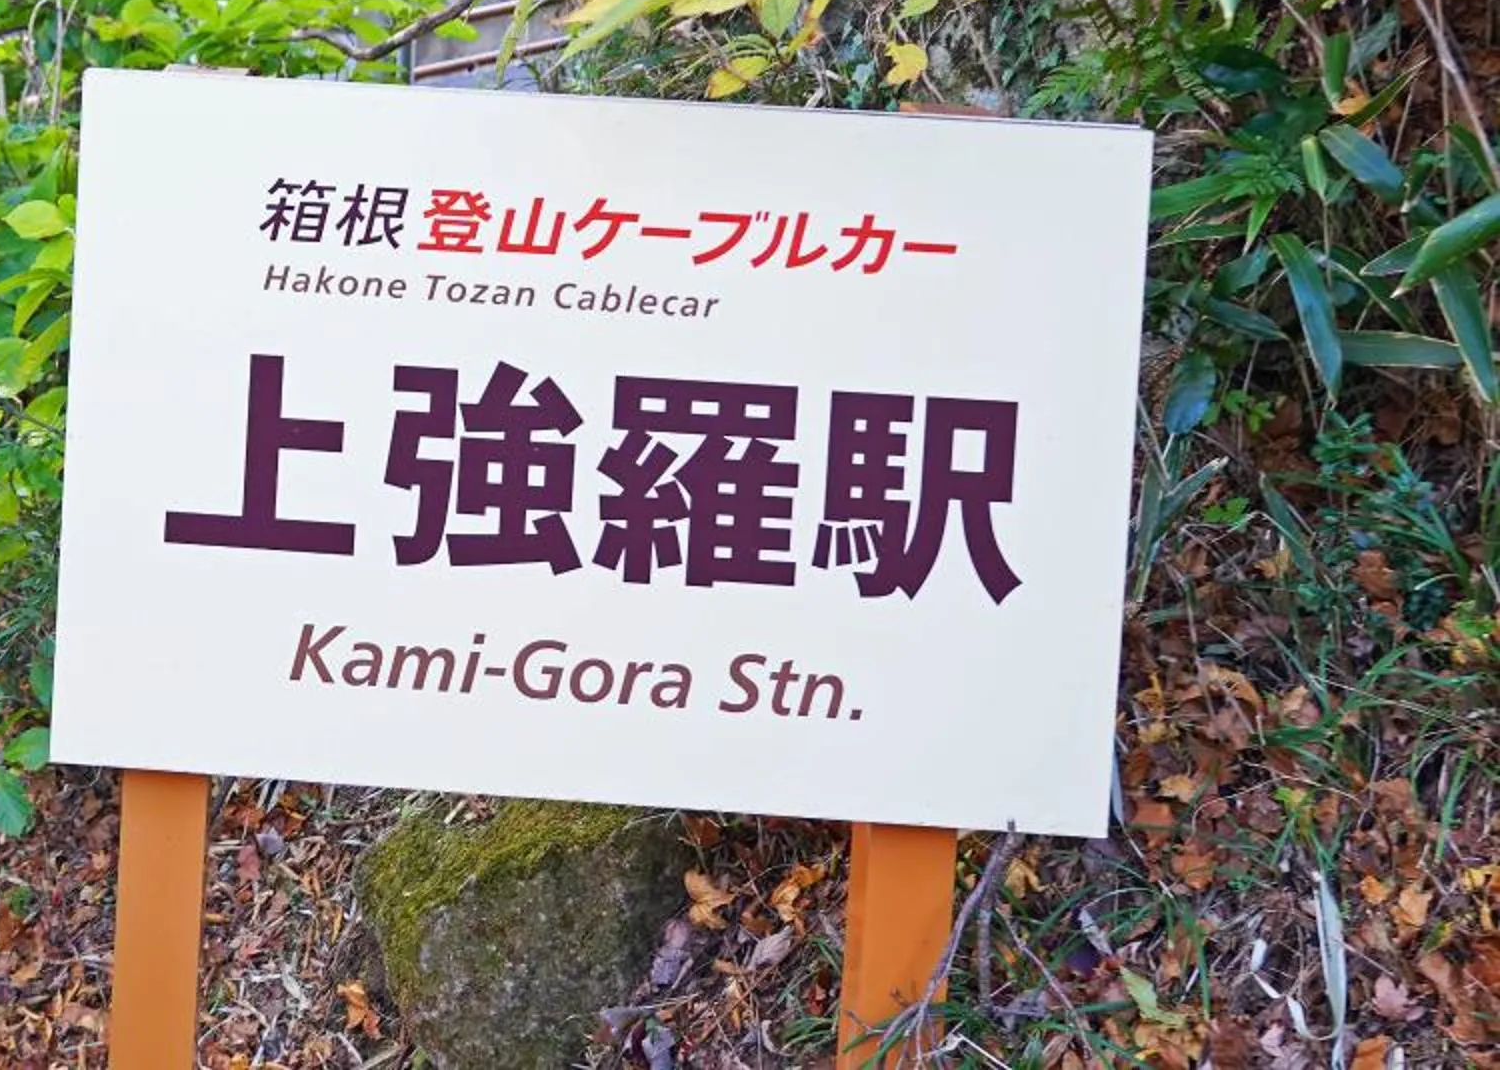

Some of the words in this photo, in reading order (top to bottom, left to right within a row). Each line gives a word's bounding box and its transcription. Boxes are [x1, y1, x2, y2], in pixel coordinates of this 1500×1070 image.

[263, 264, 407, 299] Hakone
[426, 274, 535, 307] Tozan
[553, 283, 720, 318] Cablecar
[163, 353, 1024, 606] 上強羅駅
[289, 623, 693, 709] Kami-Gora
[718, 653, 863, 721] Stn.
